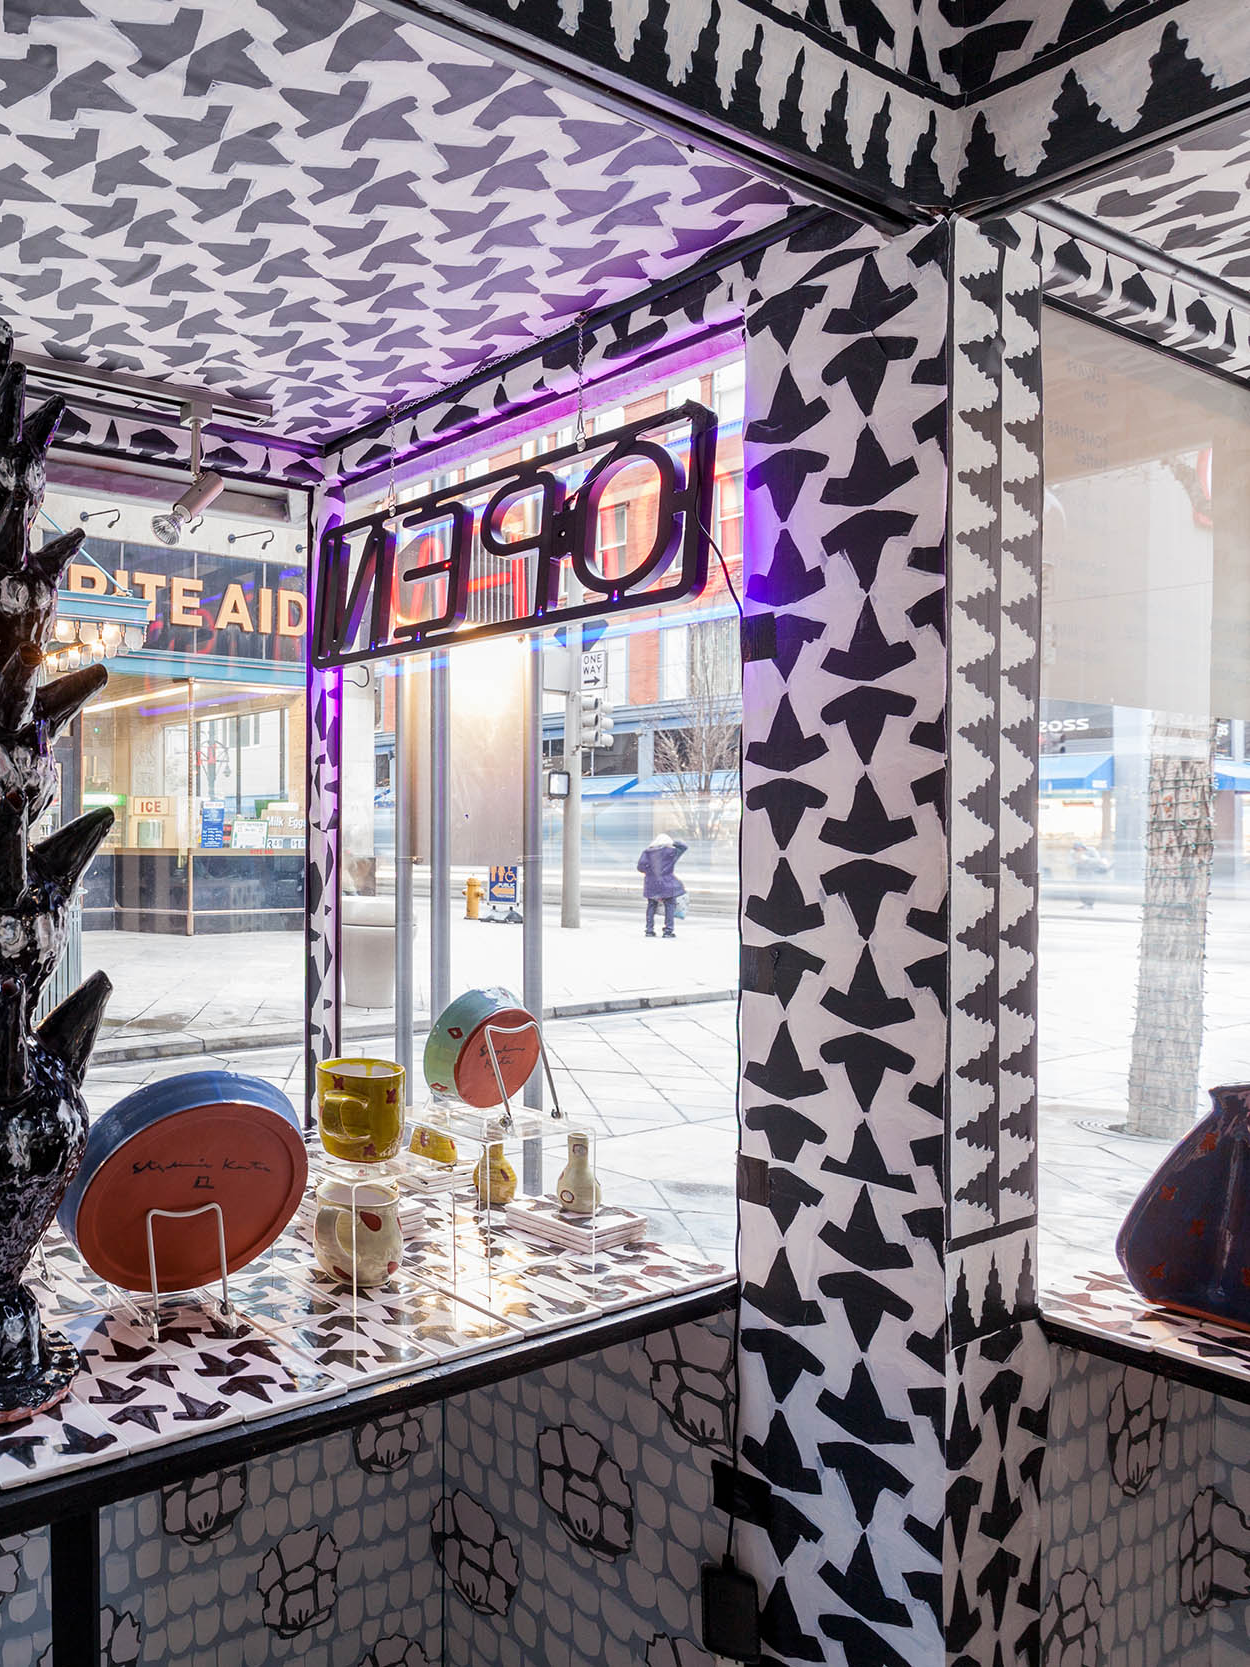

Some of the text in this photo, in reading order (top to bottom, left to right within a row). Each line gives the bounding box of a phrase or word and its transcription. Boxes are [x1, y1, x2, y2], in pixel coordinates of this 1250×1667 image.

[214, 583, 307, 636] AID
[583, 653, 602, 665] ONE
[583, 664, 603, 675] WAY
[140, 800, 161, 813] ICE
